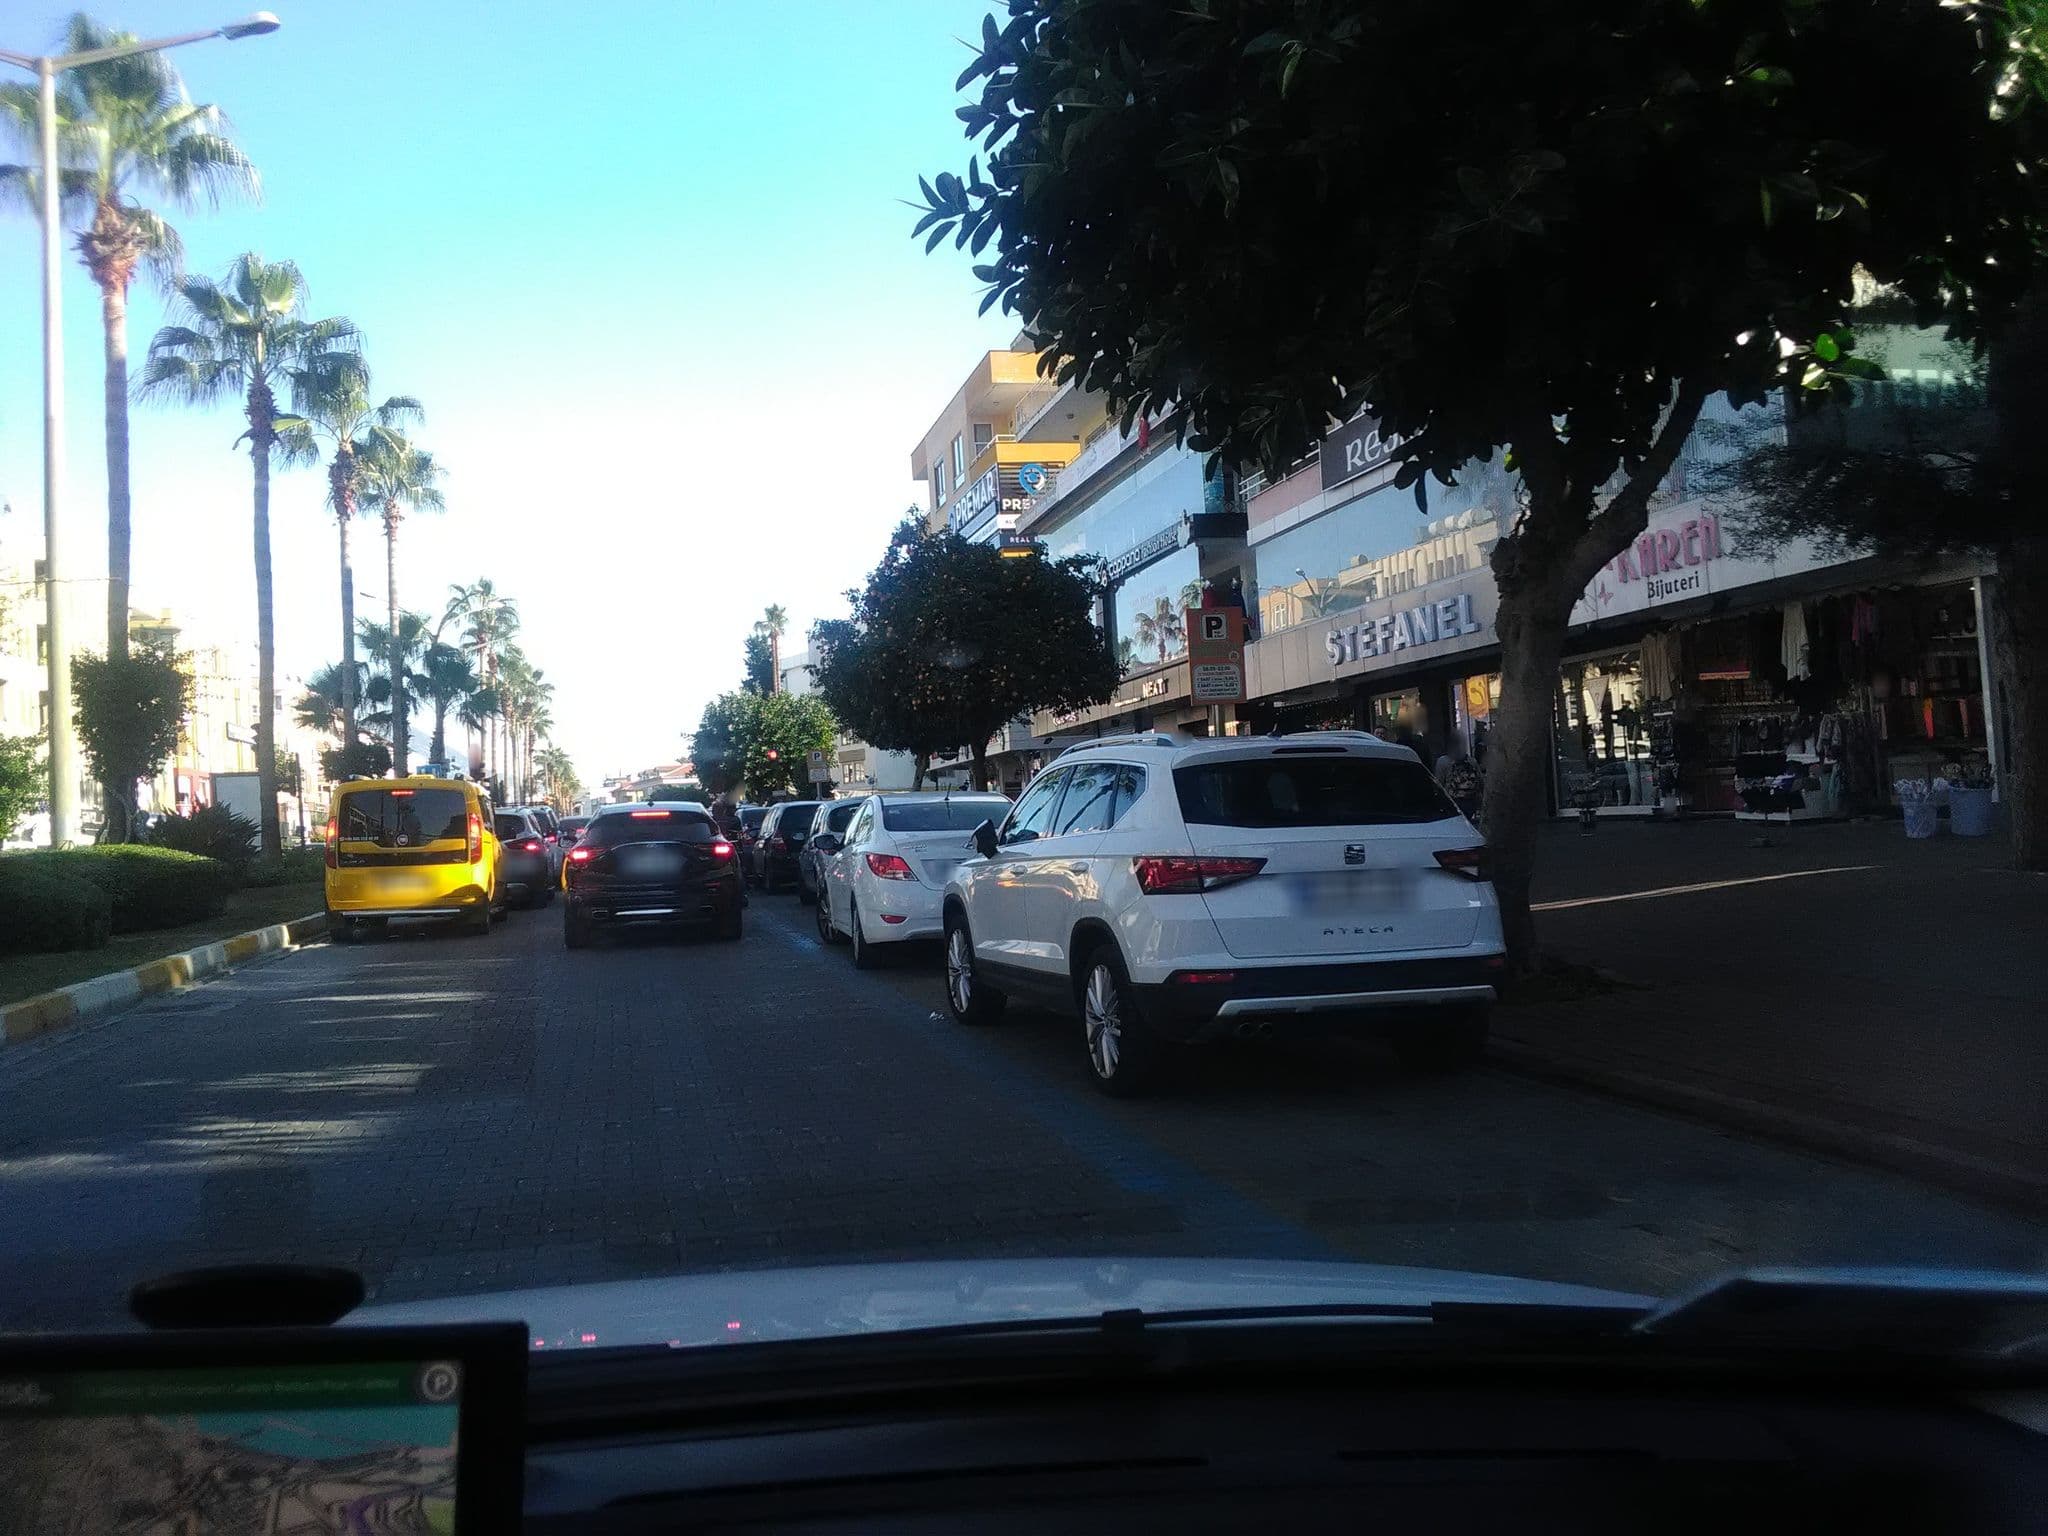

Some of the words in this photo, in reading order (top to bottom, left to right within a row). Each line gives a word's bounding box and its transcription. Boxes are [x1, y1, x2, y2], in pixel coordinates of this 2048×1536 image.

[955, 471, 996, 527] PREMAR
[1648, 571, 1699, 600] Bijuteri
[1206, 616, 1223, 638] P
[1325, 594, 1480, 664] STEFANEL
[814, 752, 821, 761] P
[1323, 926, 1394, 935] ATECA
